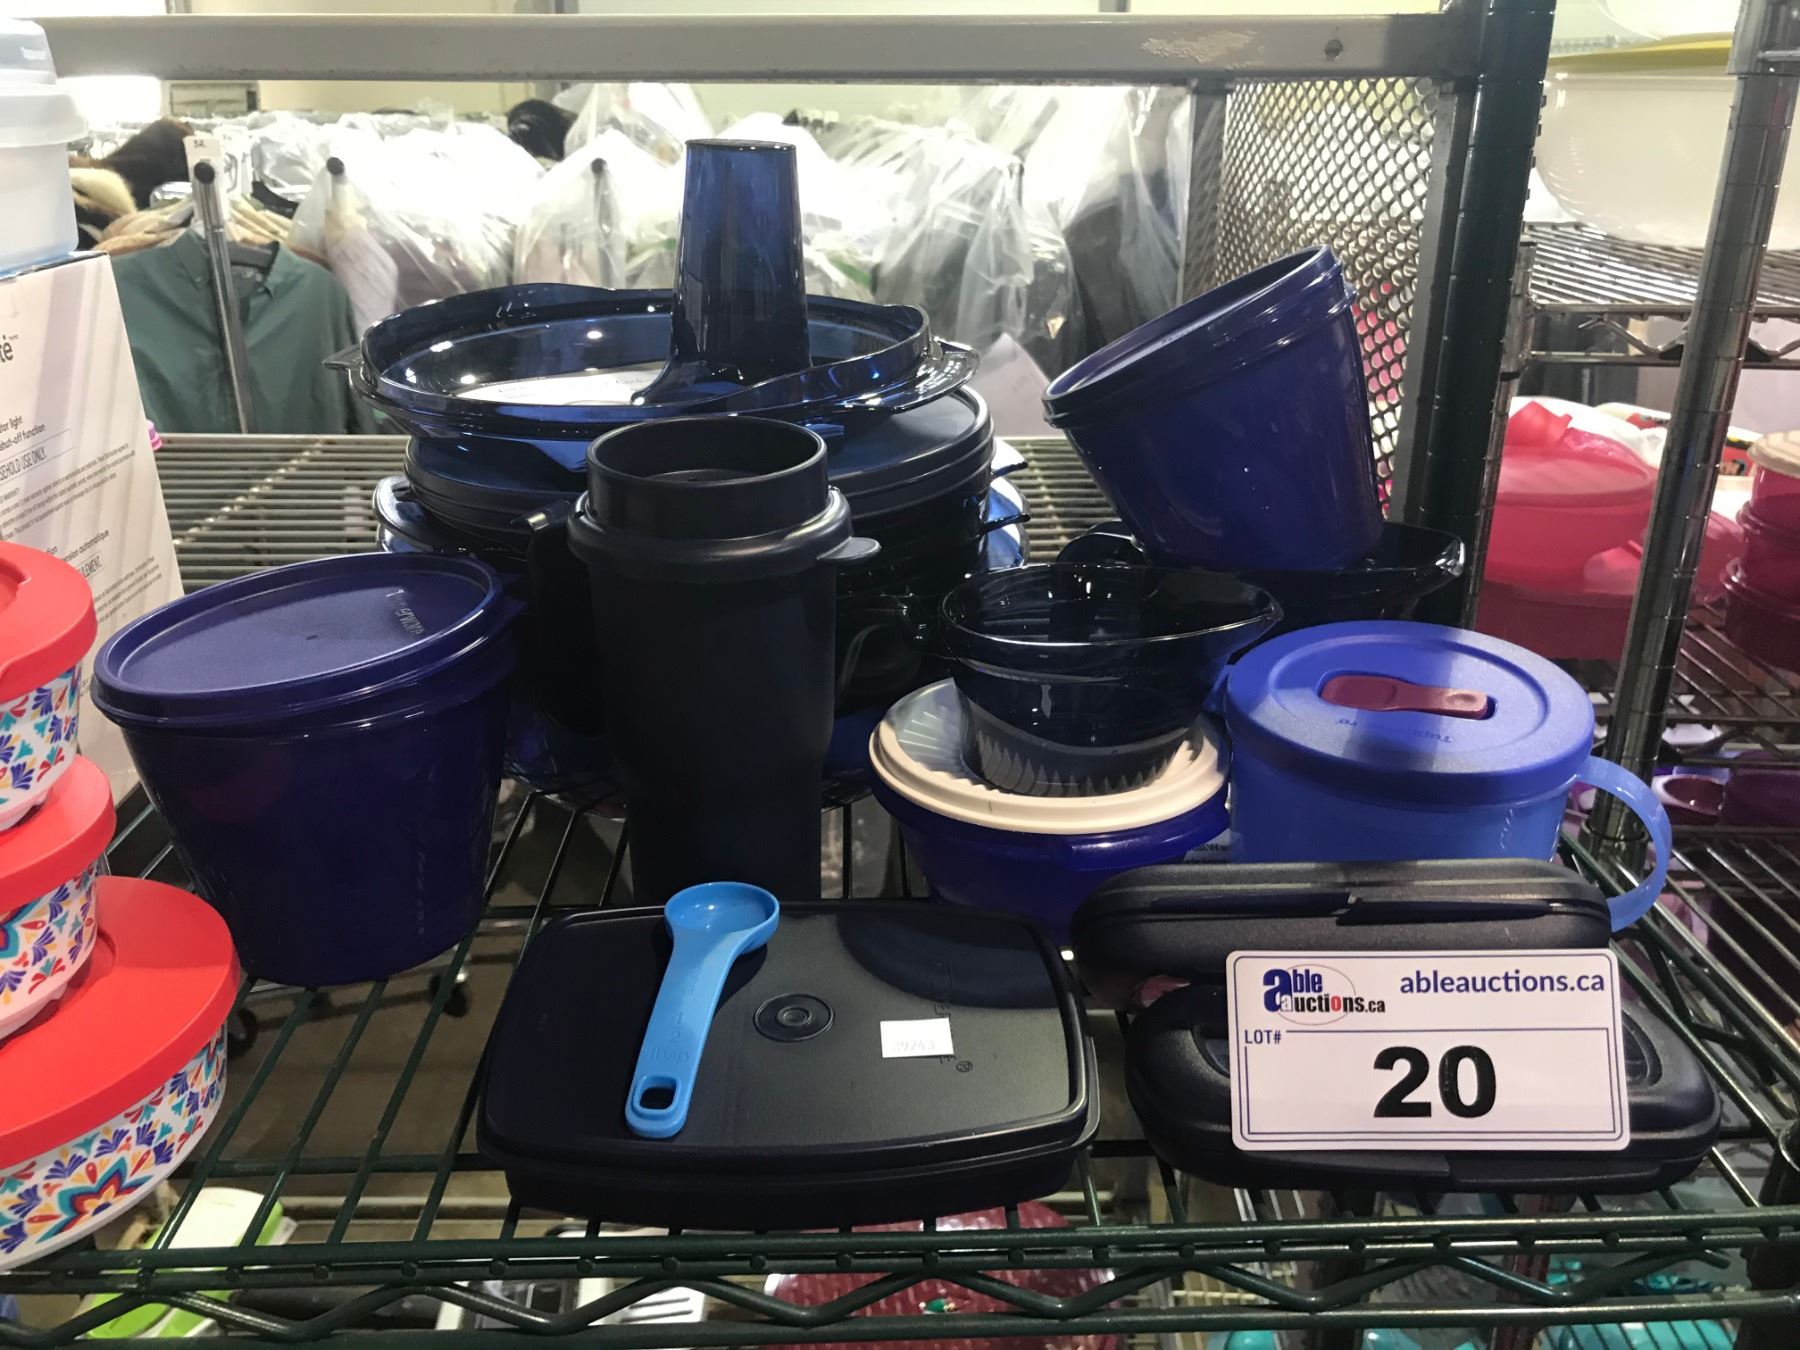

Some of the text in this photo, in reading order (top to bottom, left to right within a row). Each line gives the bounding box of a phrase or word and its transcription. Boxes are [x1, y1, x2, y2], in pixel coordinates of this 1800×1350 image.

[22, 423, 46, 441] function
[1400, 969, 1605, 993] ableauctions.ca
[1280, 994, 1386, 1013] auctions.ca
[1244, 1029, 1281, 1045] LOT#
[1373, 1045, 1497, 1118] 20
